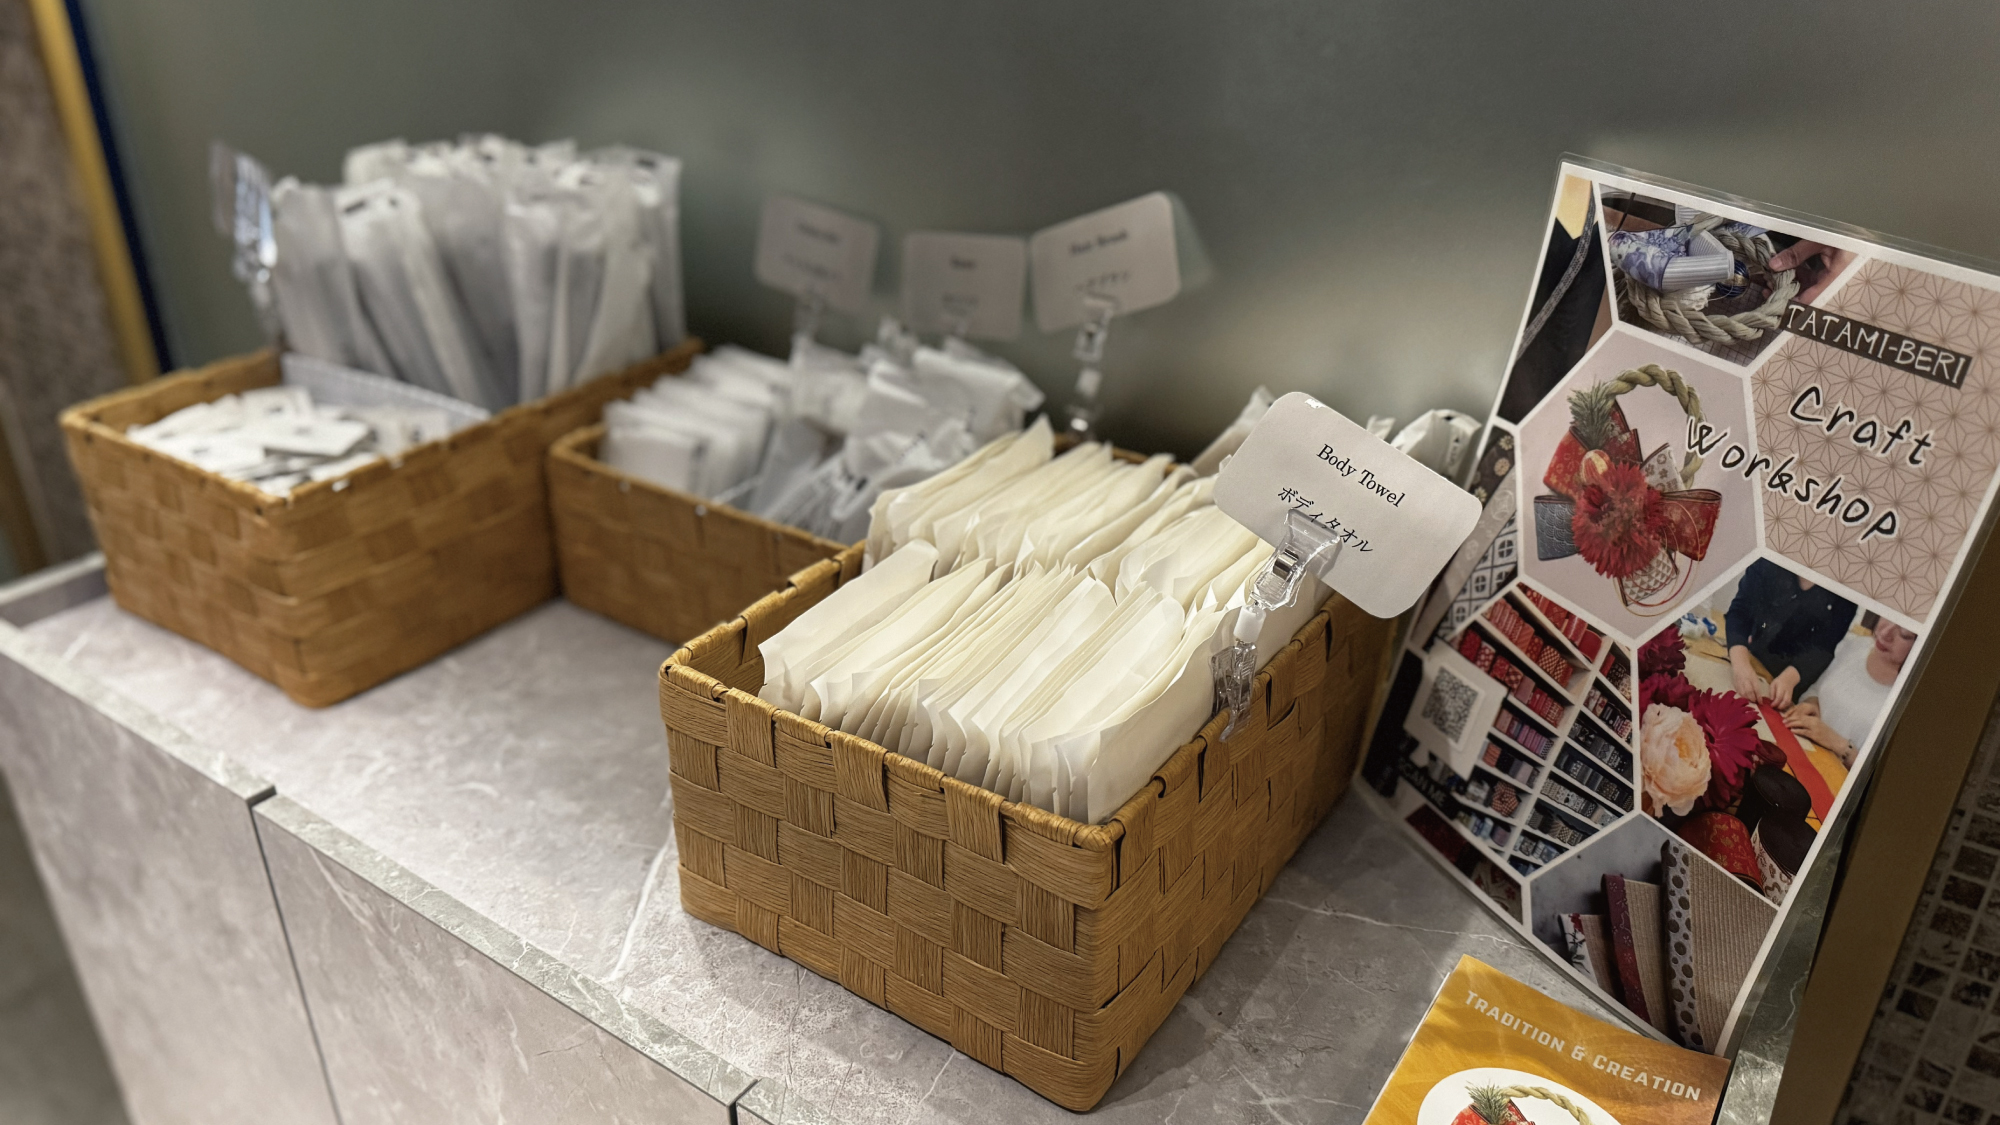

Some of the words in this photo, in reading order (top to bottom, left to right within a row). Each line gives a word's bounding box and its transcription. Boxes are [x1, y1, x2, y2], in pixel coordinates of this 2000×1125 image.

[1787, 304, 1966, 384] TATAMI-BERI
[1789, 386, 1932, 466] Craft
[1316, 443, 1357, 477] Body
[1357, 469, 1406, 508] Towel
[1687, 418, 1897, 541] Workshop
[1465, 990, 1565, 1053] TRADITION
[1570, 1045, 1586, 1062] &
[1592, 1054, 1702, 1102] CREATION
